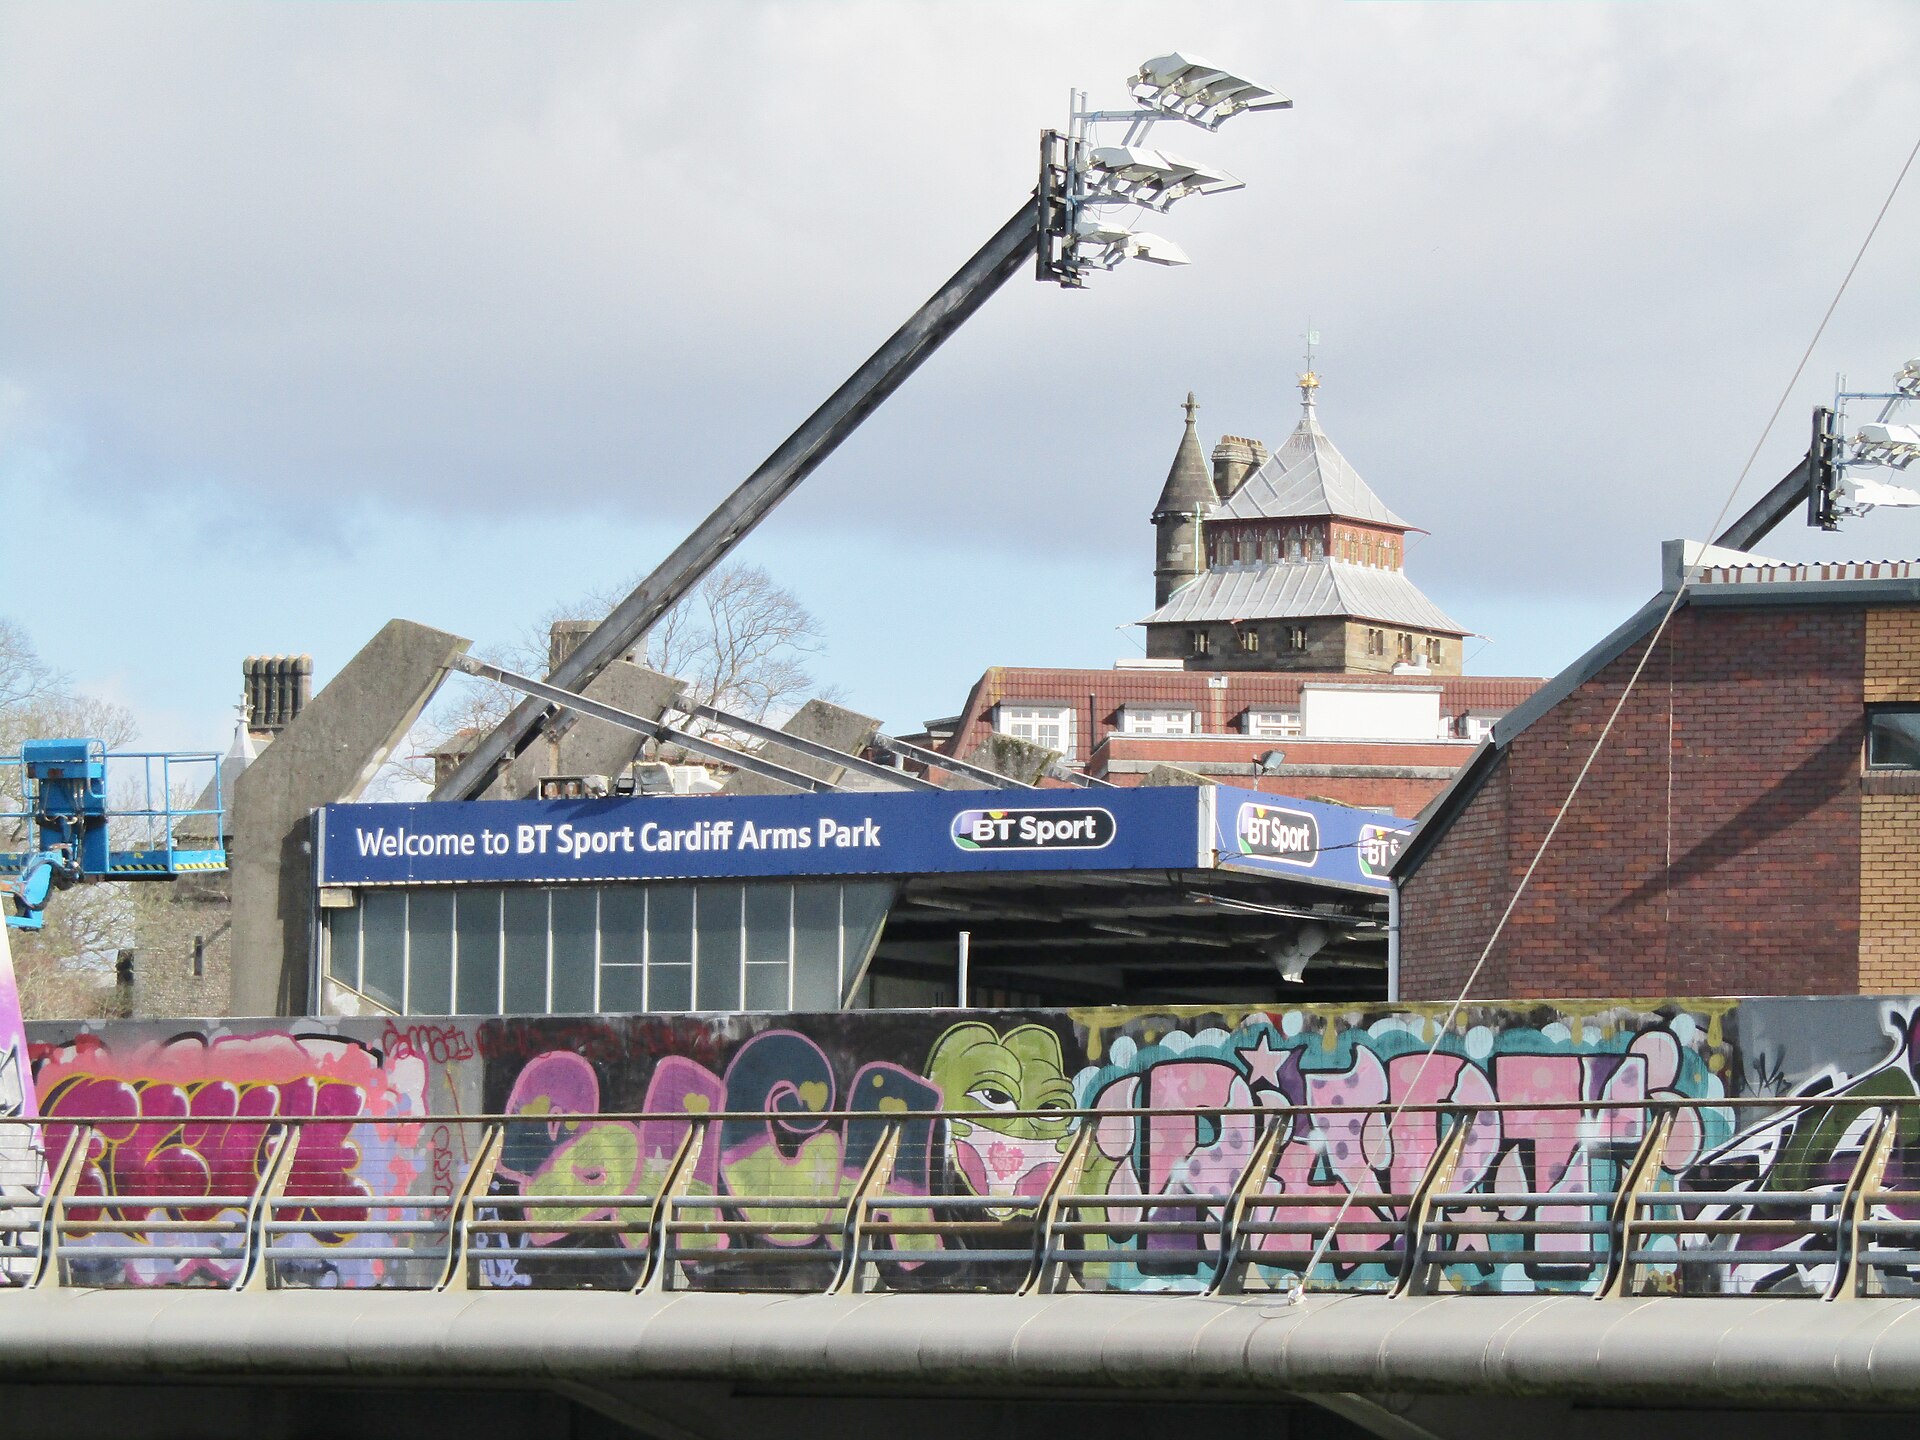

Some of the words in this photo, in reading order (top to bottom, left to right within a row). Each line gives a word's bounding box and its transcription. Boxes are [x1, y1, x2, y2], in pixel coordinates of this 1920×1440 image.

[355, 827, 476, 857] Welcome
[480, 828, 510, 855] to
[516, 824, 553, 854] BT
[556, 823, 635, 860] Sport
[639, 820, 734, 853] Cardiff
[736, 820, 812, 850] Arms
[818, 817, 881, 848] Park
[972, 818, 1016, 841] BT
[1019, 815, 1097, 845] Sport
[1247, 816, 1271, 847] BT
[1271, 816, 1310, 853] Sport
[1367, 838, 1390, 867] BT
